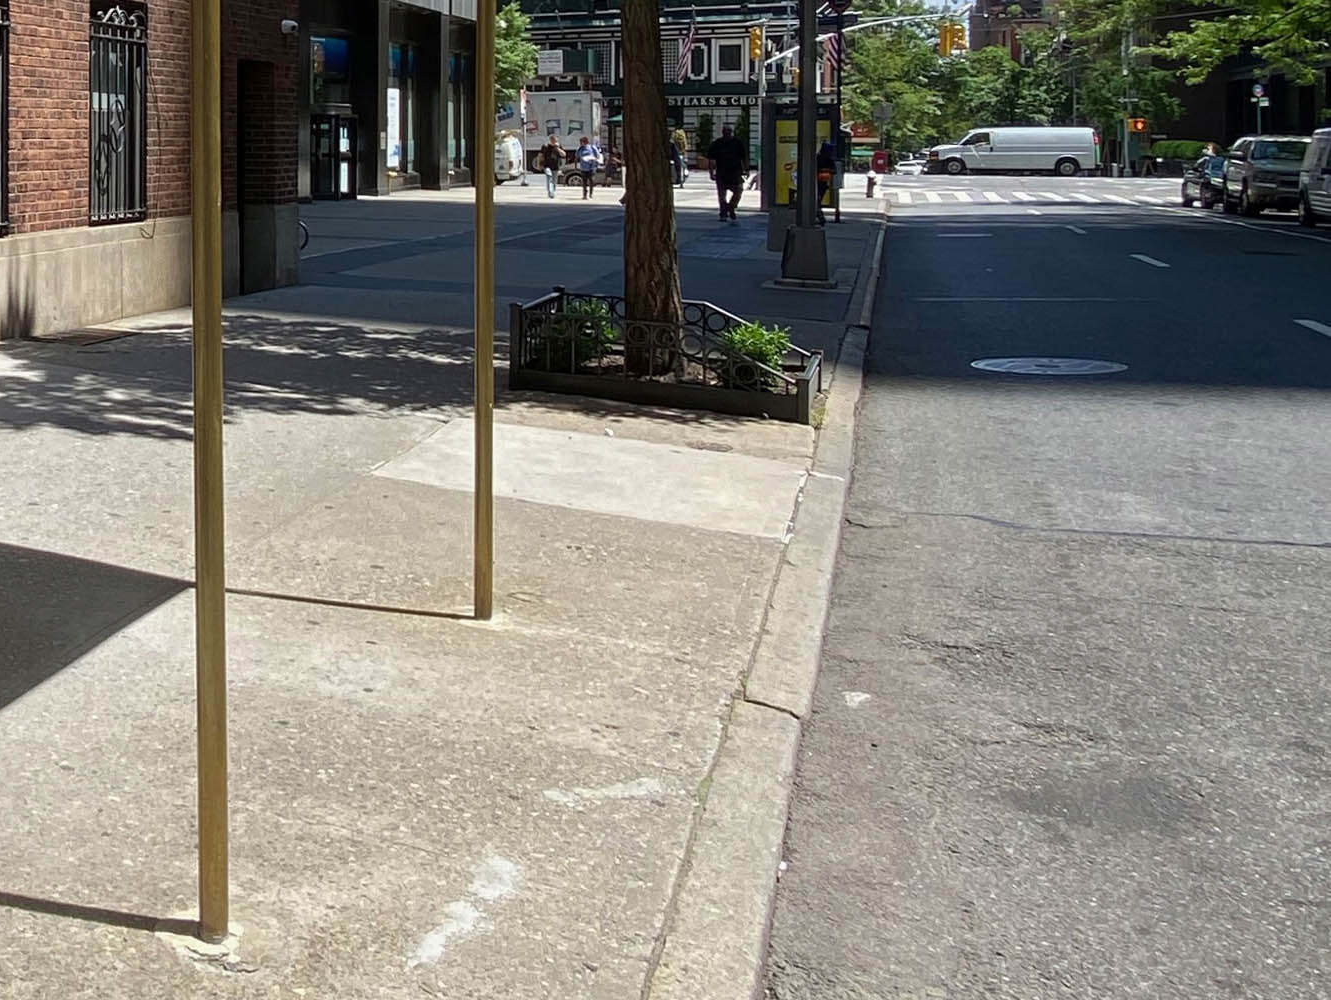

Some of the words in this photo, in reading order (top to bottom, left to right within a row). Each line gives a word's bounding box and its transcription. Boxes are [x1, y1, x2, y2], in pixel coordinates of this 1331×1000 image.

[668, 96, 716, 106] STEAKS
[719, 96, 727, 106] &
[731, 96, 759, 105] CHO
